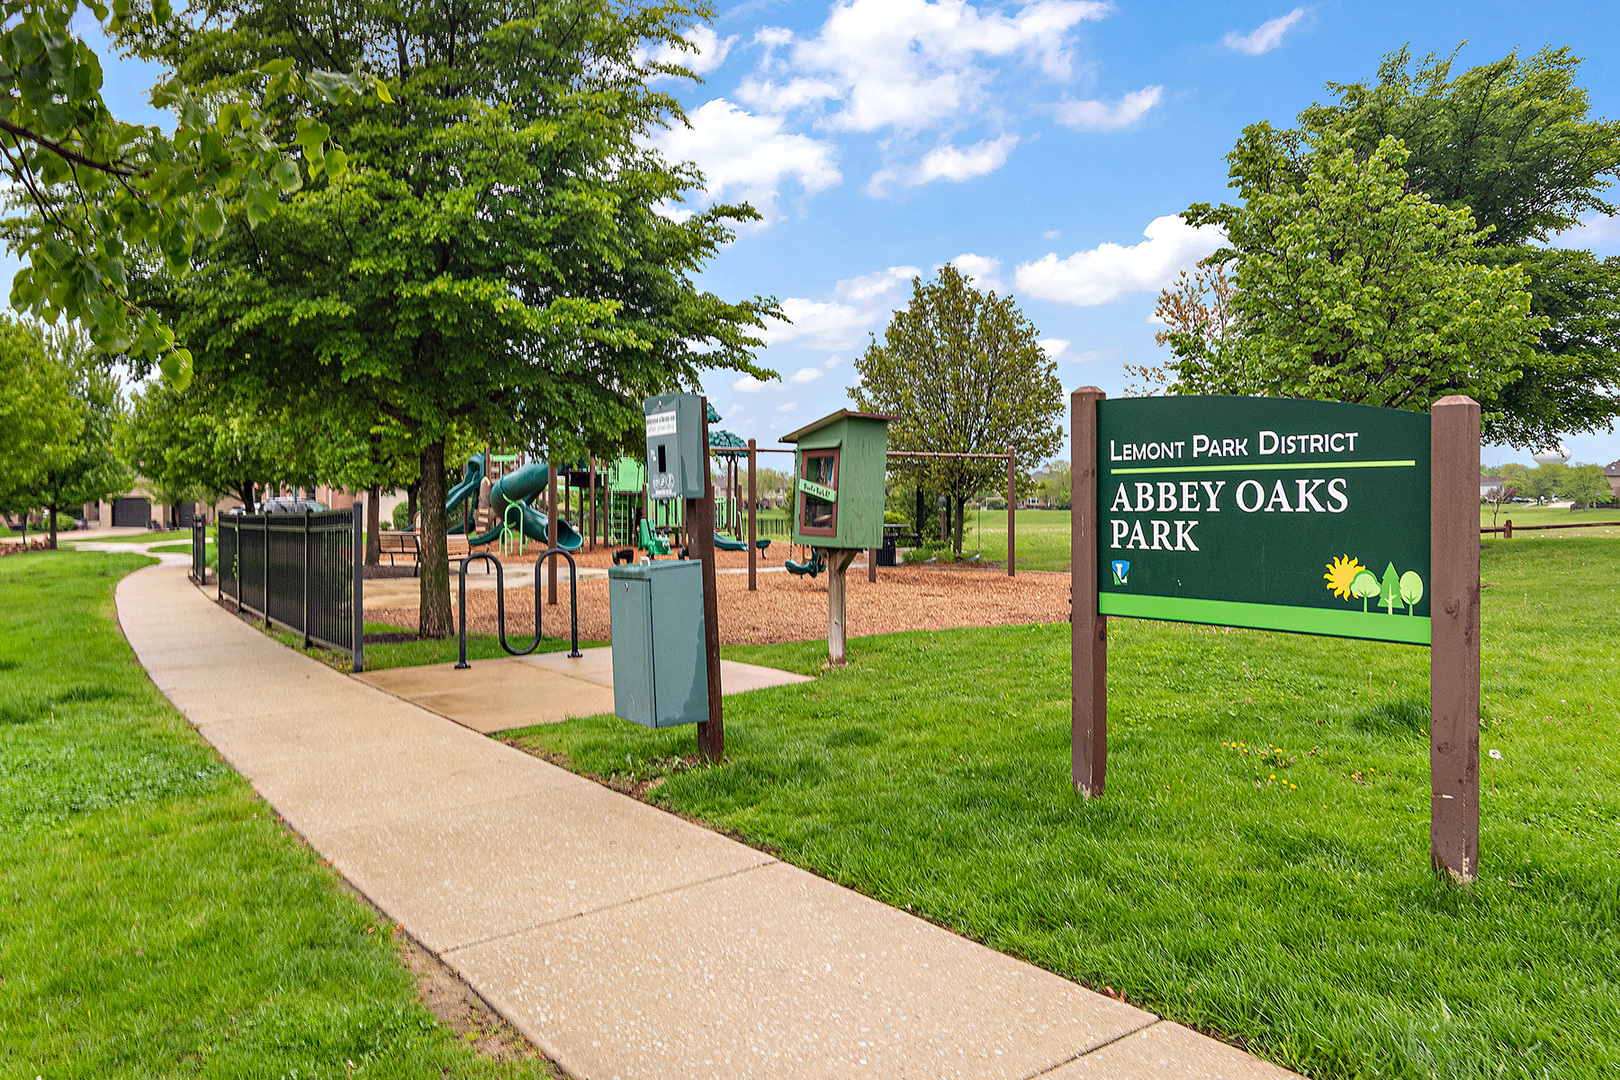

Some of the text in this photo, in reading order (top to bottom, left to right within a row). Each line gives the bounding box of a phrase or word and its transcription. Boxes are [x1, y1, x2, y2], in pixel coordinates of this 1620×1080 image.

[1110, 430, 1359, 461] LEMONT PARK DISTRICT
[1109, 477, 1349, 513] ABBEY OAKS
[1109, 519, 1200, 552] PARK
